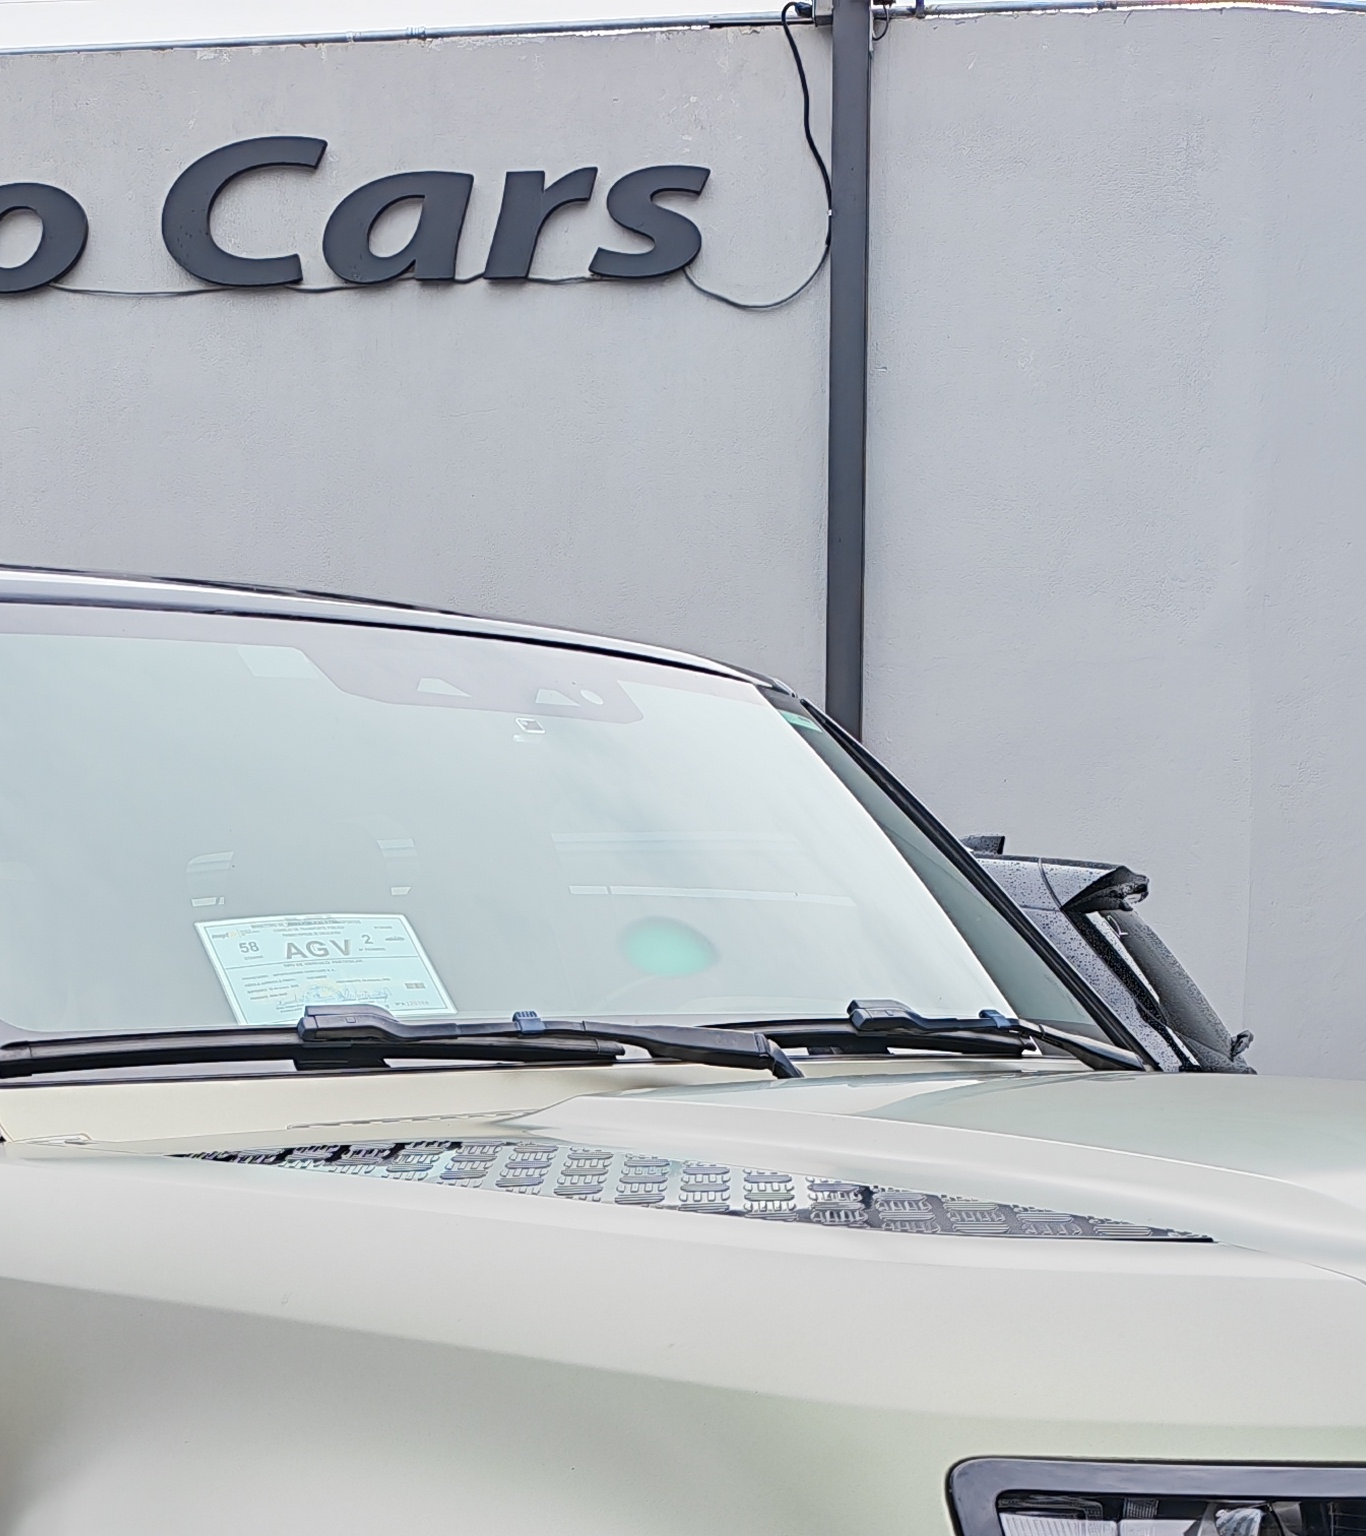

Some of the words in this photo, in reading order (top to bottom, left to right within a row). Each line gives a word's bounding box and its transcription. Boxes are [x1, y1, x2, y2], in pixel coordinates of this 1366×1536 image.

[161, 135, 710, 287] Cars
[238, 941, 260, 953] 58
[286, 938, 352, 960] AGV
[361, 934, 374, 945] 2
